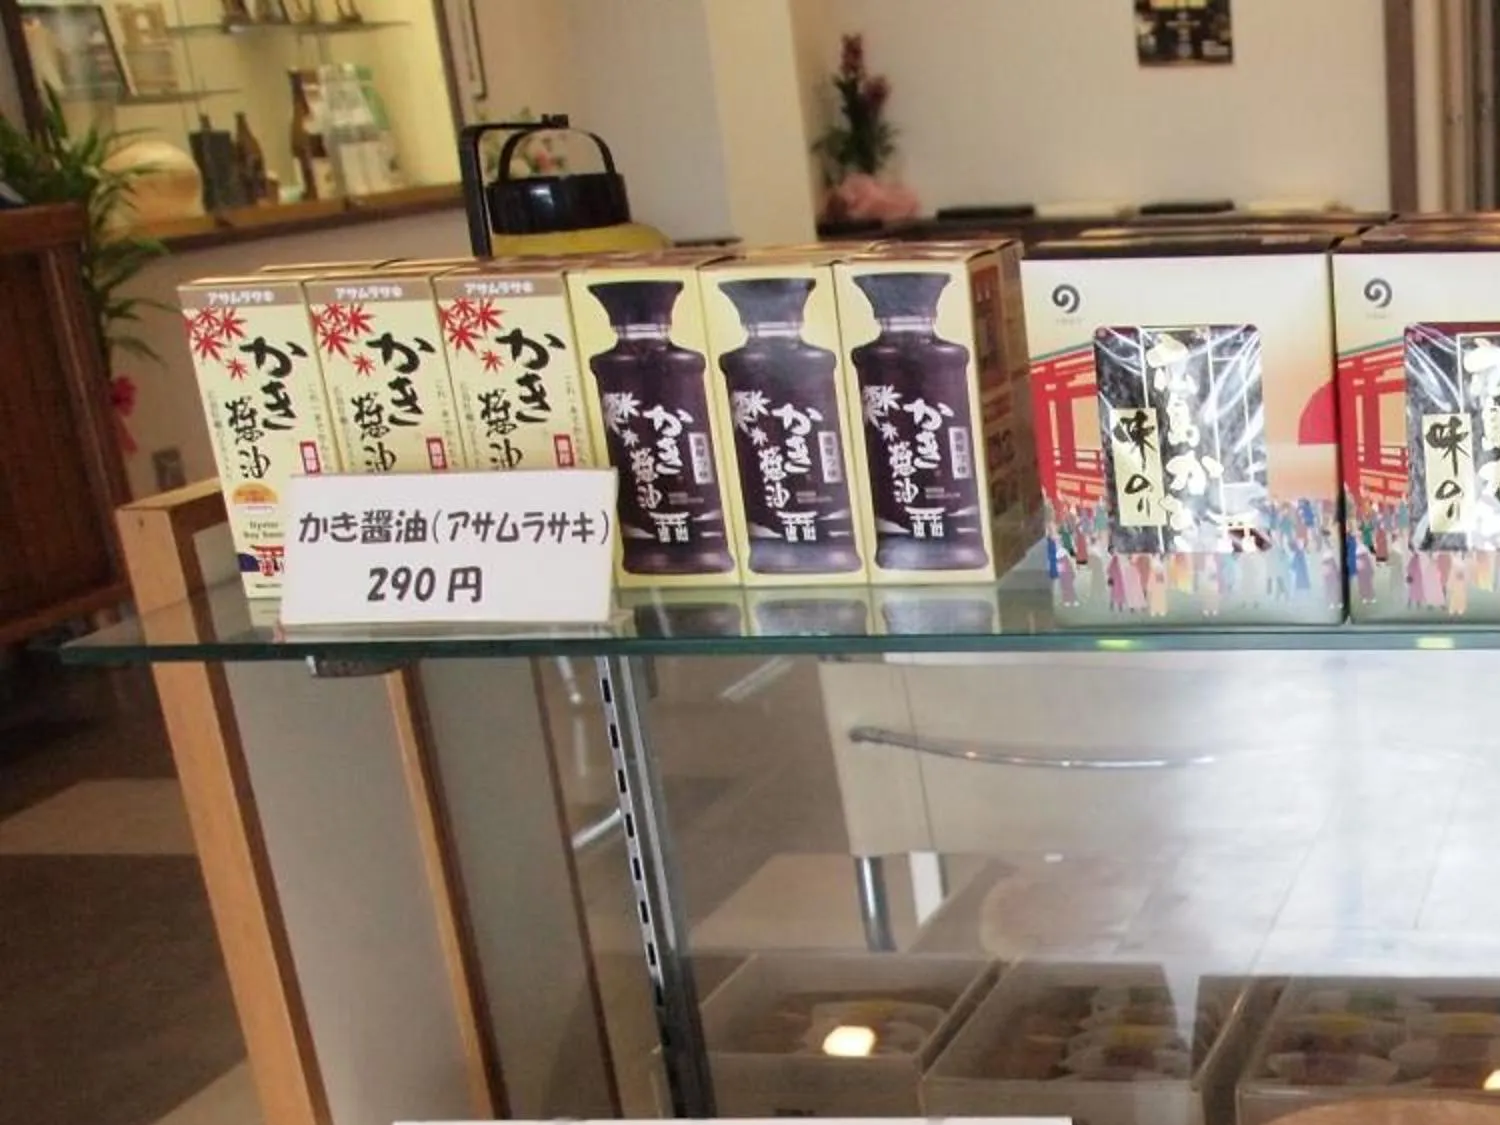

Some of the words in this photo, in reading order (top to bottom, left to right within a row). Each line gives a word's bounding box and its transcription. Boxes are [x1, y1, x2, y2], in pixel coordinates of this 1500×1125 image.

[1425, 415, 1470, 520] 味のり
[298, 510, 610, 546] かき醤油(アサムラサキ)
